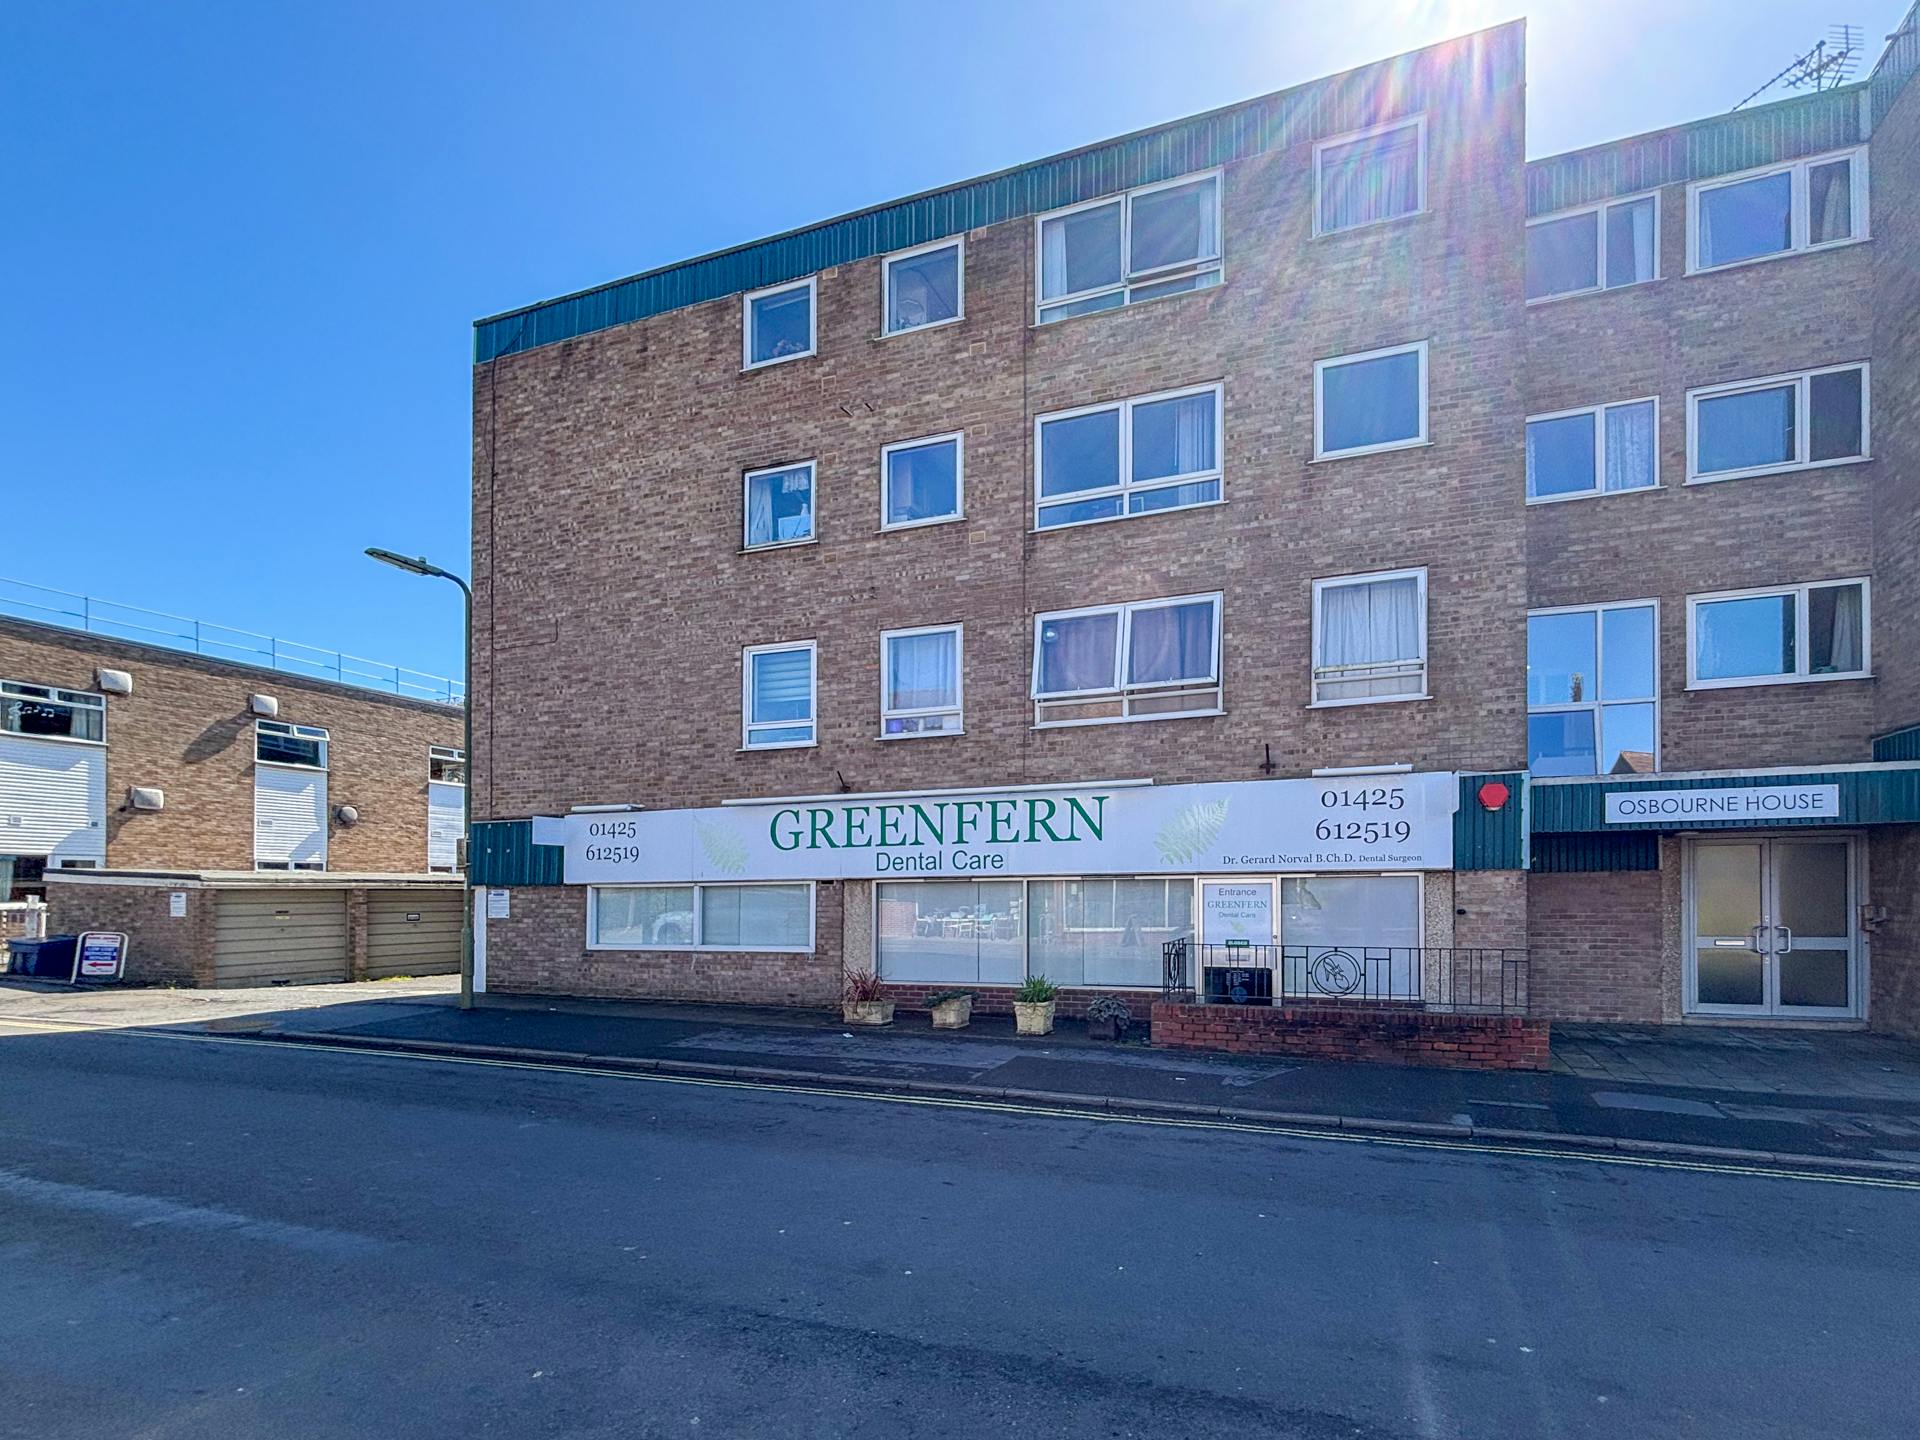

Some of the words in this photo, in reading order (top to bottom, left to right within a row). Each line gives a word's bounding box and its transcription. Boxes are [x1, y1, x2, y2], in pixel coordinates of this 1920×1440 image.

[1321, 788, 1405, 811] 01425
[1618, 795, 1739, 815] OSBOURNE
[1746, 793, 1824, 812] HOUSE
[589, 821, 637, 839] 01425
[770, 796, 1109, 850] GREENFERN
[1315, 818, 1411, 844] 612519
[586, 844, 640, 864] 612519
[876, 850, 942, 872] Dental
[952, 849, 1004, 870] Care
[1223, 855, 1238, 865] Dr.
[1240, 854, 1275, 865] Gerard
[1278, 853, 1313, 864] Norval
[1359, 854, 1386, 862] Dental
[1388, 854, 1422, 864] Surgeon
[1218, 888, 1257, 896] Entrance
[1207, 900, 1268, 909] GREENFERN
[1218, 911, 1239, 919] Dental
[1240, 911, 1256, 919] Care
